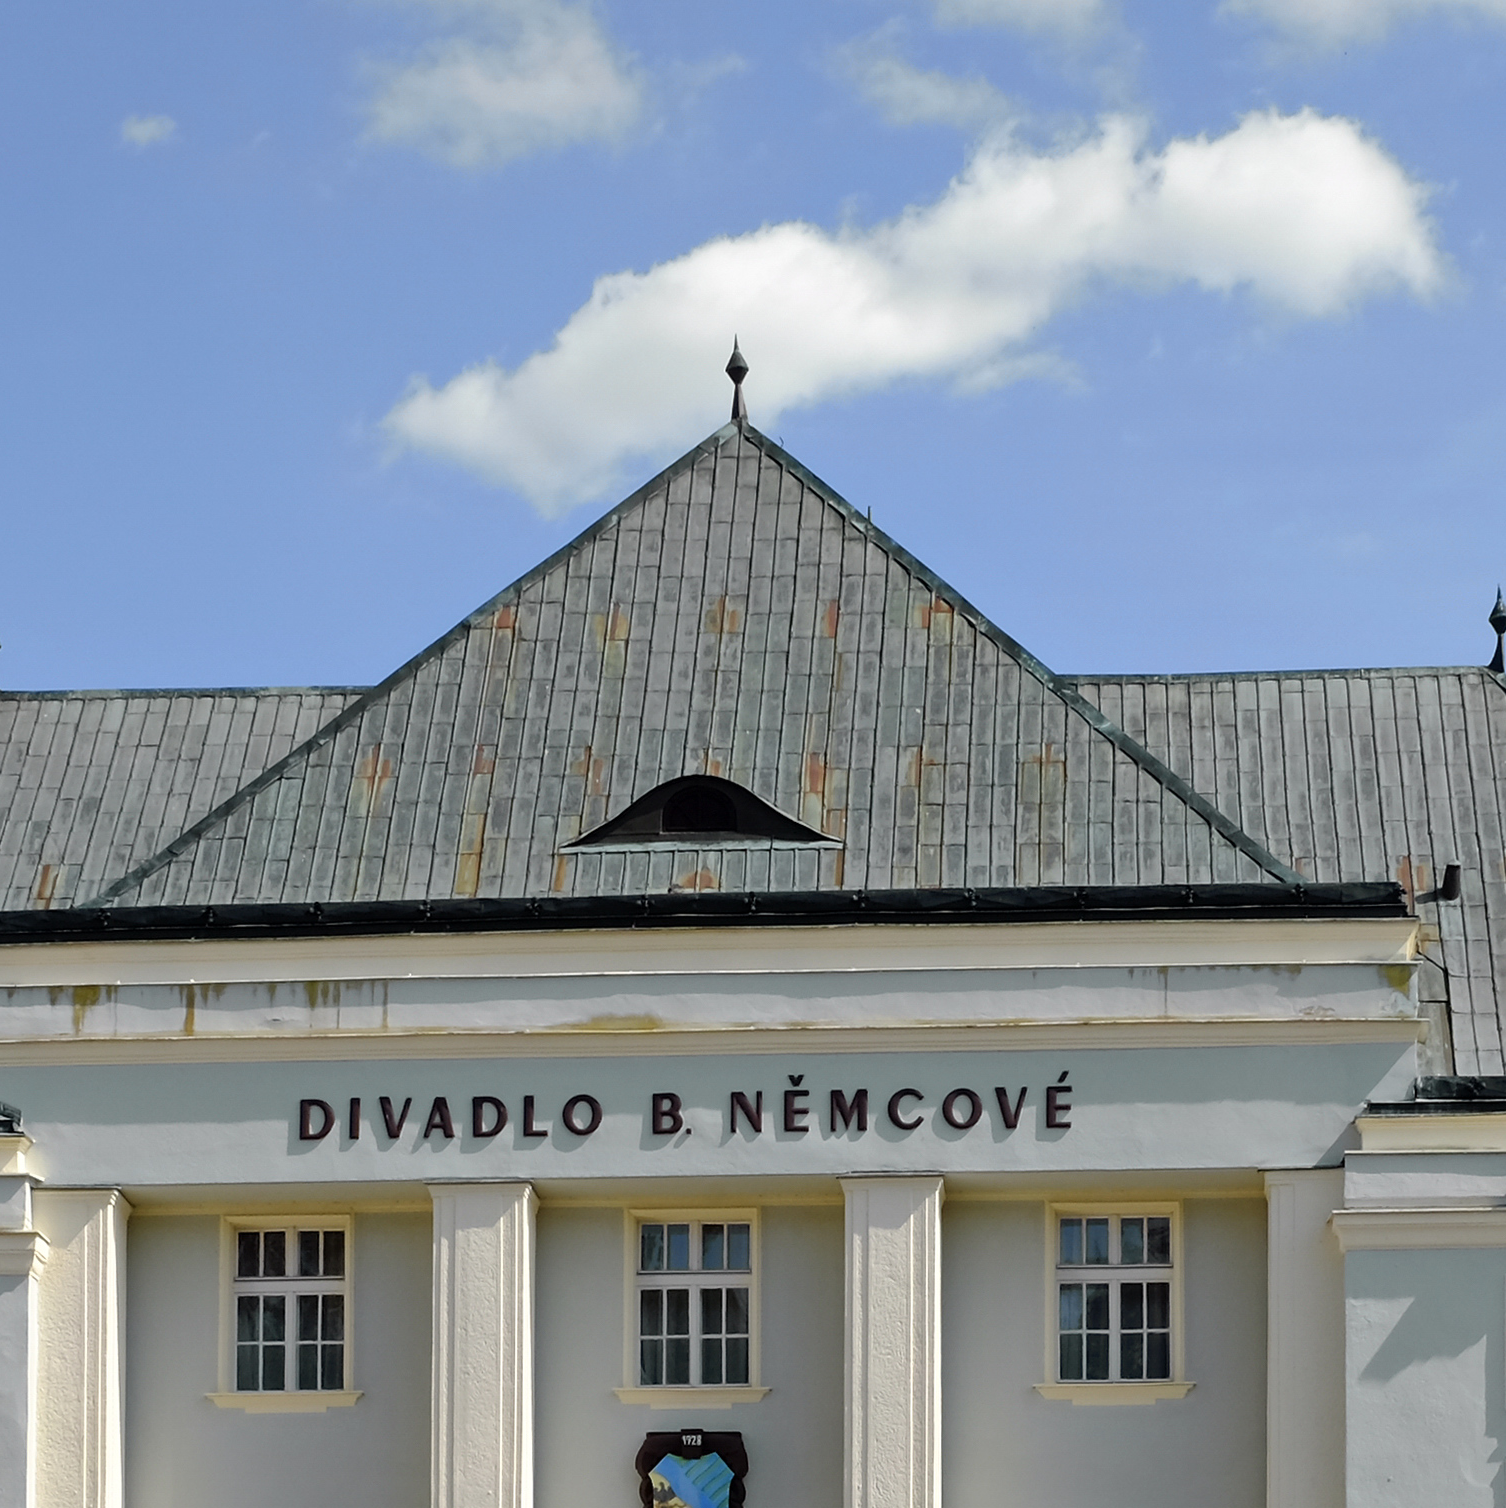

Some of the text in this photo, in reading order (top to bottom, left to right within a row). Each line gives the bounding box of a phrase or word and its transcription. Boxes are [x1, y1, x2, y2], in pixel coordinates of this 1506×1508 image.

[299, 1070, 1073, 1140] DIVADLO B. NĚMCOVÉ
